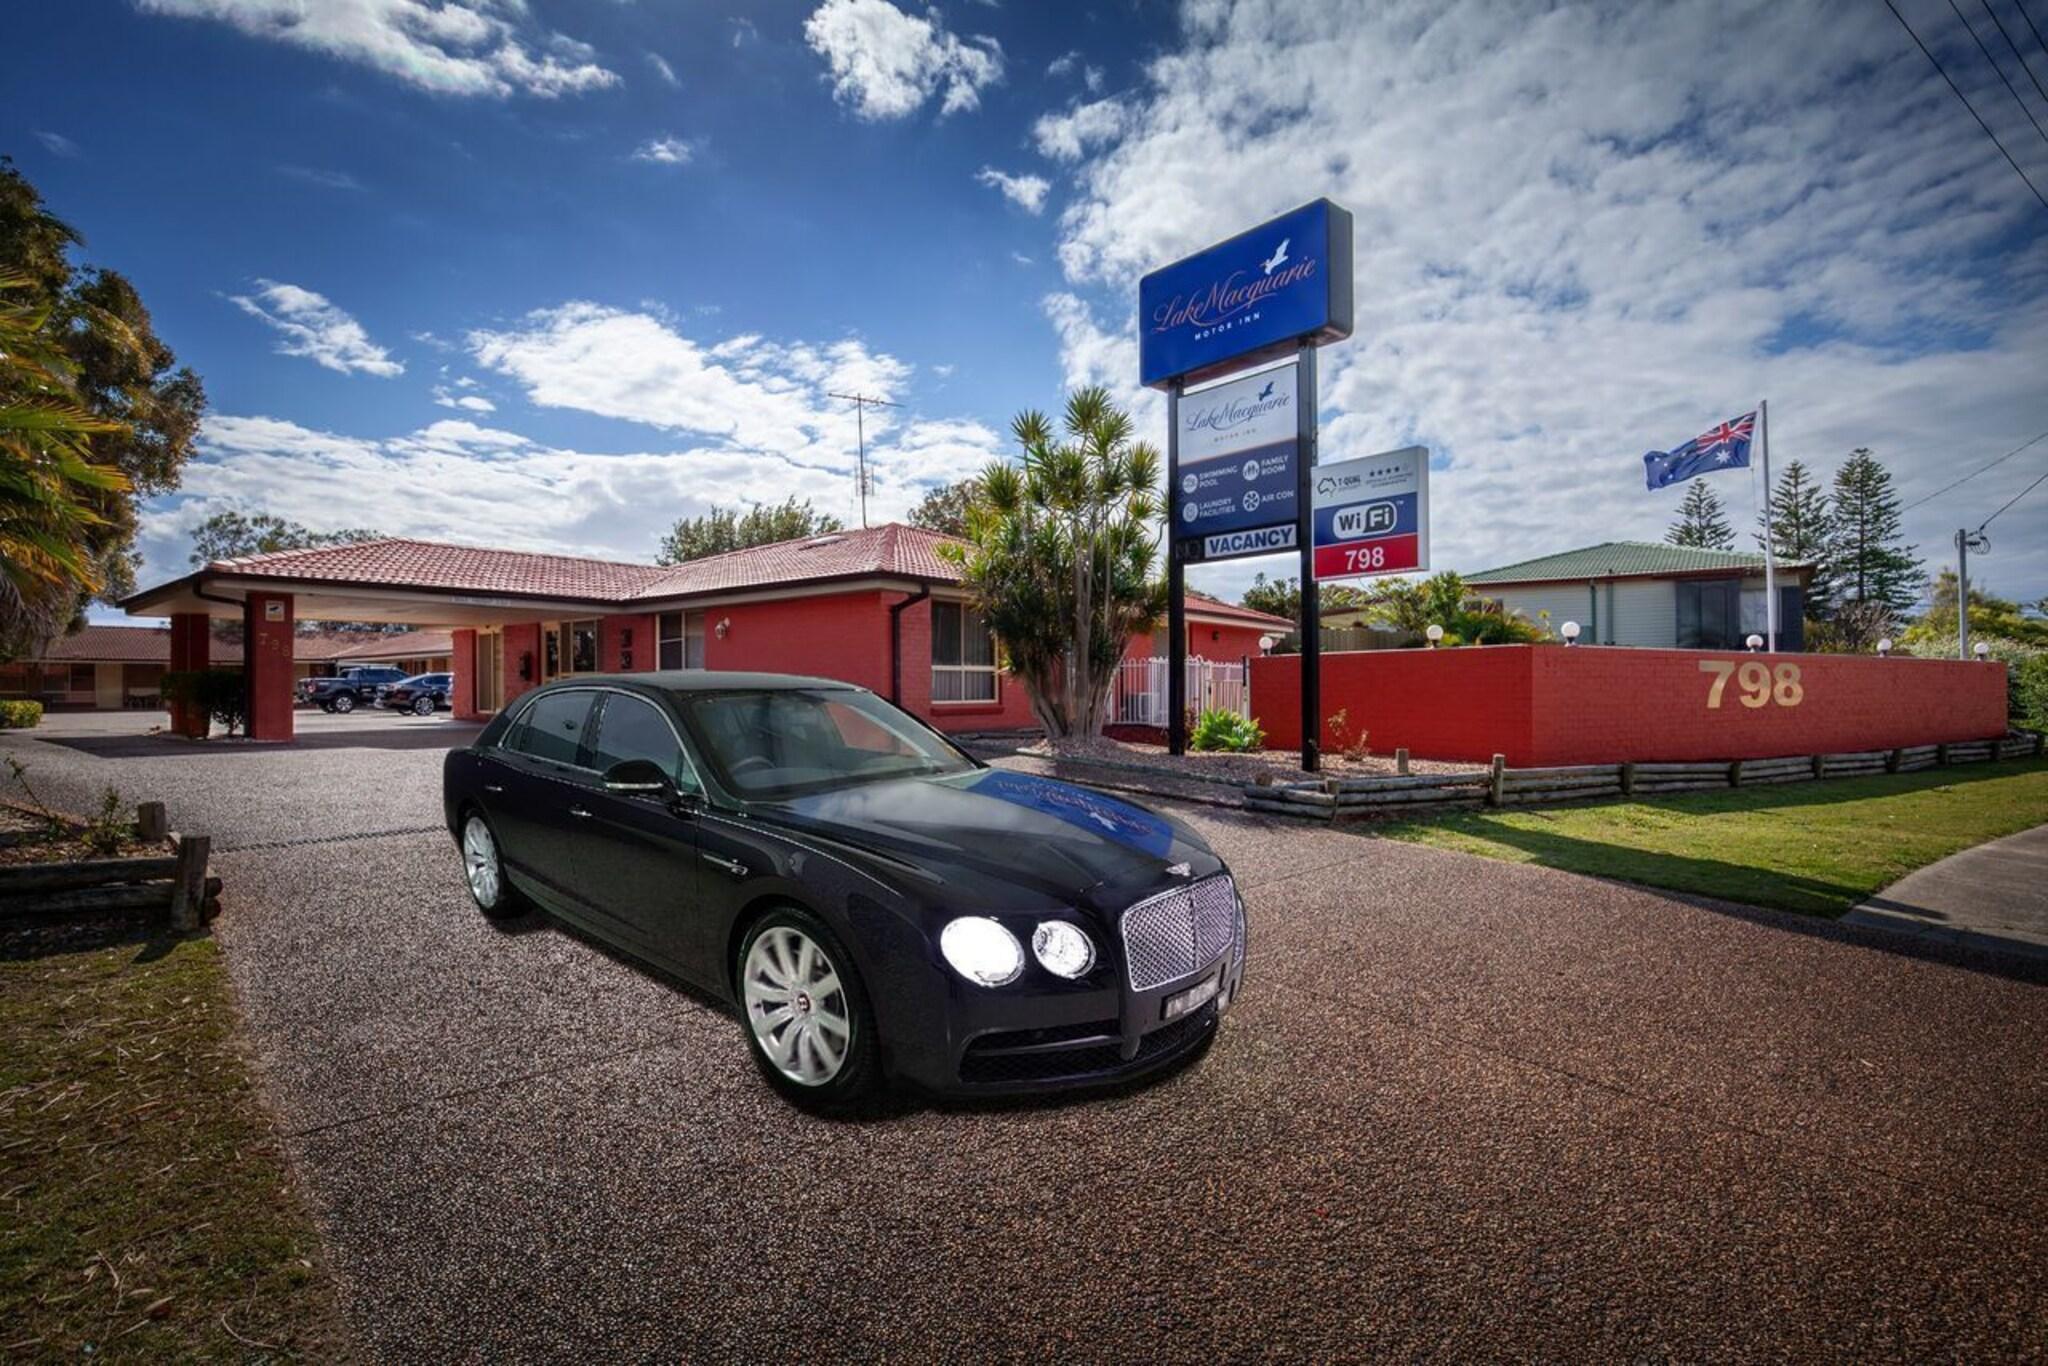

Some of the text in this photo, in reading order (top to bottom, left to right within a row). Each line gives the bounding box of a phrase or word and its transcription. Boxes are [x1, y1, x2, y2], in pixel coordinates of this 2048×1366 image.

[1152, 257, 1317, 333] Lake Macquarie
[1194, 312, 1261, 341] MOTOR INN
[1186, 392, 1291, 432] Lake Macquarie
[1261, 455, 1289, 466] FAMILY
[1199, 465, 1238, 479] SWIMMING
[1261, 464, 1286, 475] ROOM
[1199, 479, 1218, 488] POOL
[1261, 490, 1294, 503] AIR CON
[1199, 498, 1232, 510] LAUNDRY
[1199, 505, 1236, 518] FACILITIES
[1209, 527, 1293, 554] VACANCY
[1345, 546, 1385, 571] 798
[1698, 660, 1804, 708] 798
